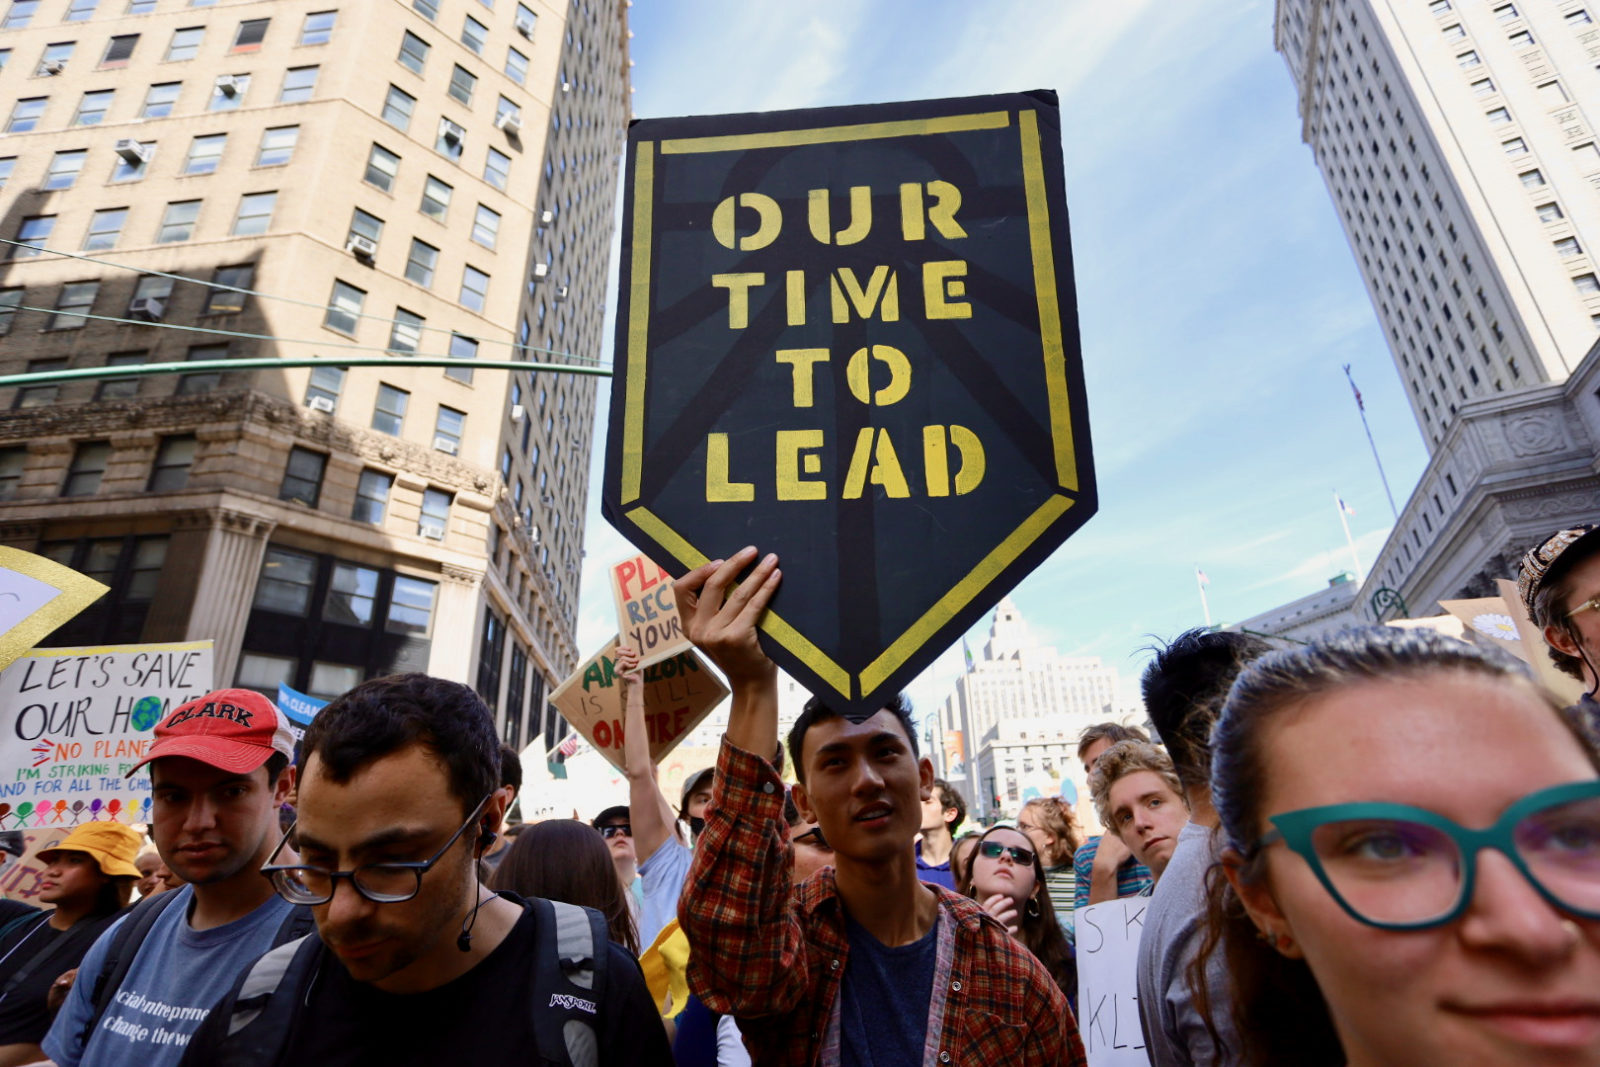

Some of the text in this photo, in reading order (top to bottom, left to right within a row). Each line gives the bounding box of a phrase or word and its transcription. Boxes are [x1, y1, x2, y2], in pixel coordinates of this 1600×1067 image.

[711, 179, 969, 252] OUR
[711, 259, 973, 330] TIME
[775, 344, 913, 408] TO
[705, 424, 987, 503] LEAD
[626, 582, 675, 626] REC
[629, 615, 682, 657] YOUR
[19, 651, 201, 694] LET'S SAVE
[15, 696, 104, 741] OUR
[166, 702, 254, 729] CLARK
[581, 695, 603, 717] IS
[54, 737, 157, 763] NO PLANE
[0, 782, 26, 798] AND
[34, 780, 63, 796] FOR
[68, 778, 93, 793] ALL
[100, 777, 122, 791] THE
[16, 767, 41, 782] I'M
[50, 763, 110, 779] STRIKING
